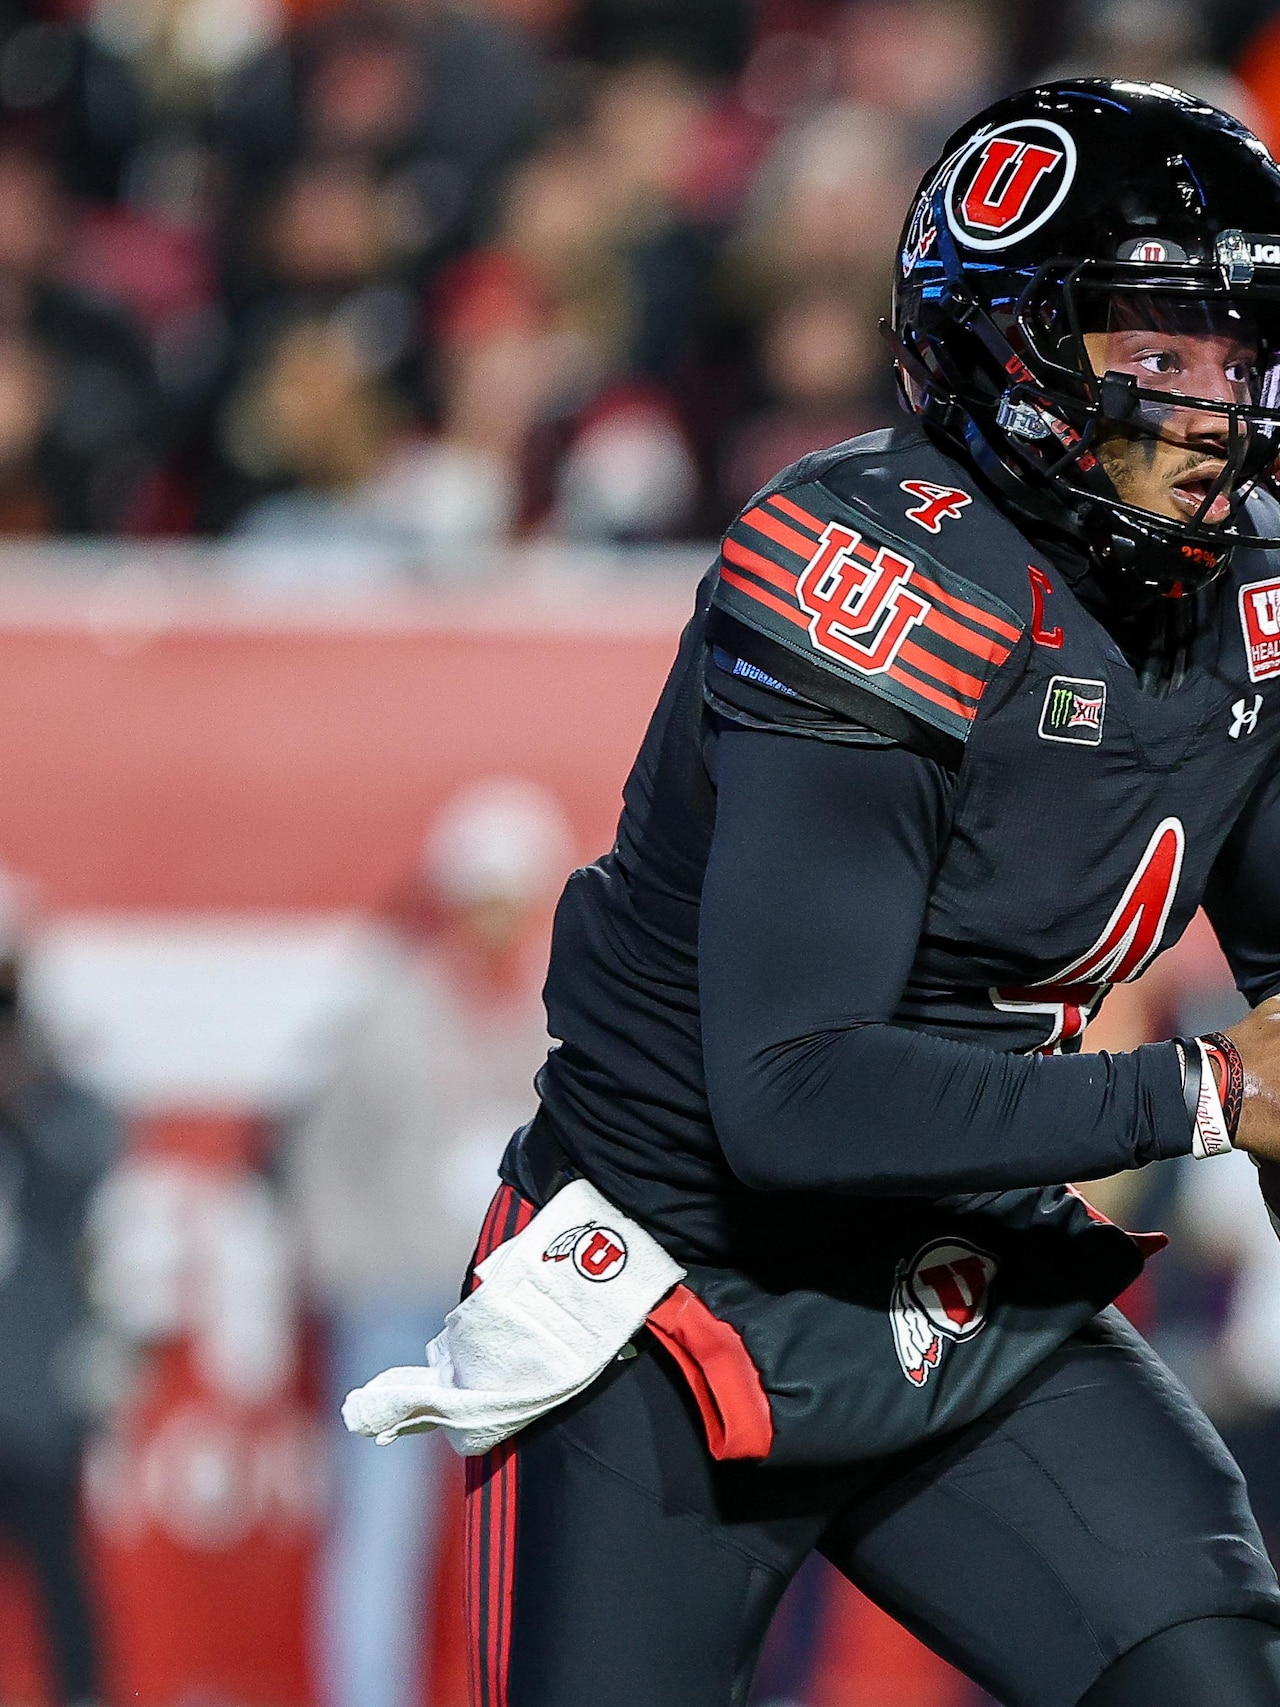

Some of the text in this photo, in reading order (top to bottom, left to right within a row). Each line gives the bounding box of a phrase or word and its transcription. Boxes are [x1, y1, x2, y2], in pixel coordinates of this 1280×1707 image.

[960, 137, 1063, 233] U
[900, 479, 972, 534] 4
[988, 815, 1186, 1056] 4
[581, 1231, 623, 1275] U
[917, 1255, 988, 1328] U
